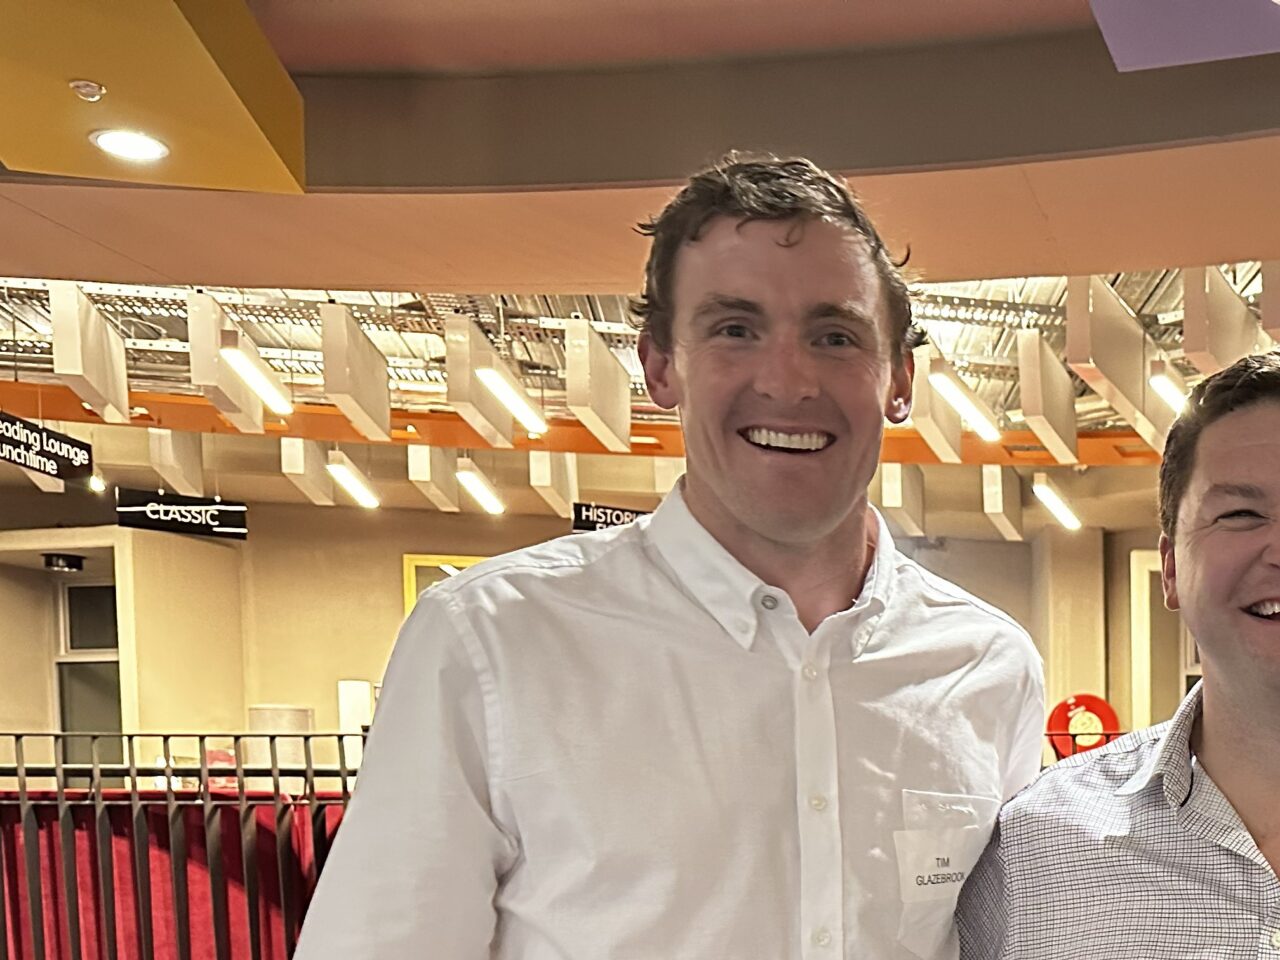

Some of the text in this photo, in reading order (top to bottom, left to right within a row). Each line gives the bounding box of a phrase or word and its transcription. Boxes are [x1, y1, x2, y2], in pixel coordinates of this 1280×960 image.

[43, 432, 89, 466] Lounge
[146, 503, 220, 525] CLASSIC
[936, 857, 950, 868] TIM
